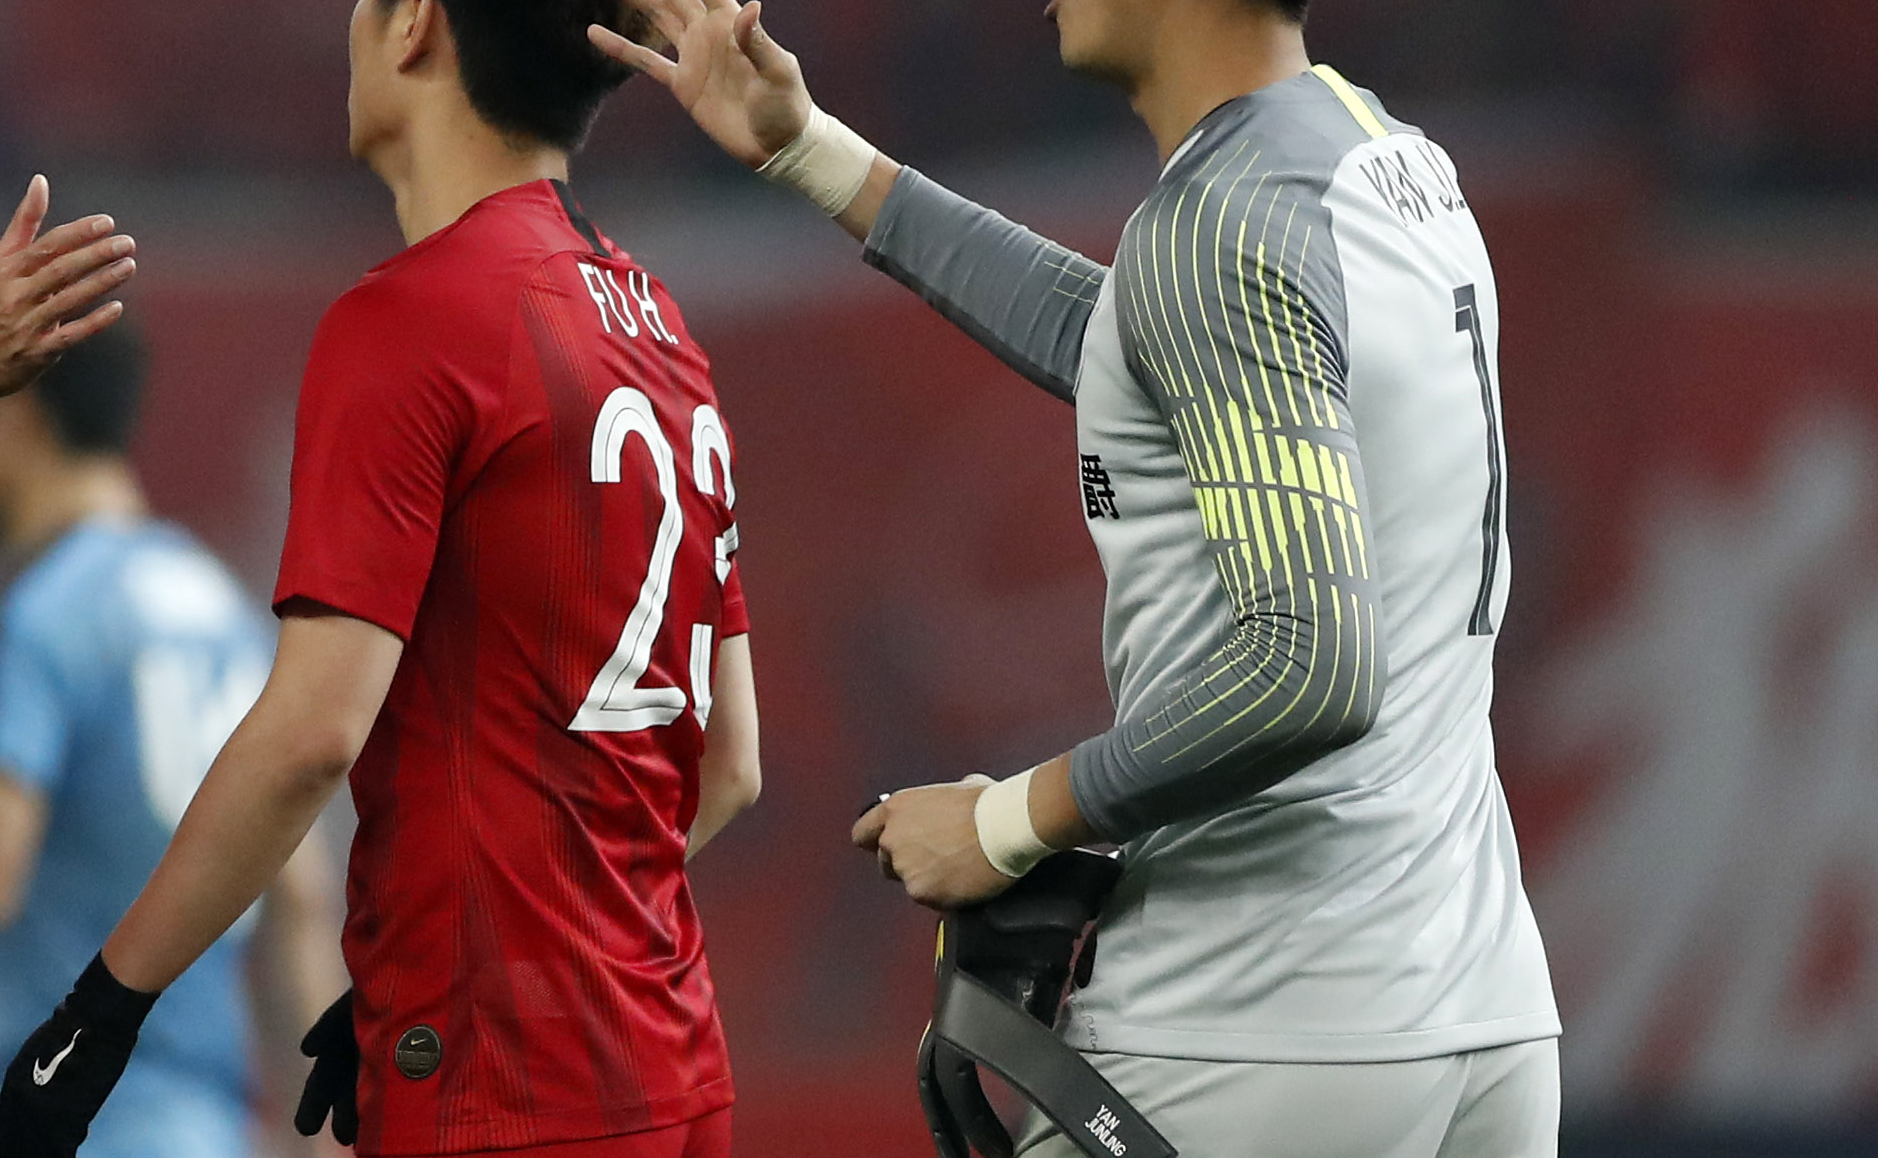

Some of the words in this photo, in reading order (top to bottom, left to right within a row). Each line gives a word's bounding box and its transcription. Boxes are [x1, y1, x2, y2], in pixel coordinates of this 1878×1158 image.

[1358, 149, 1435, 228] YAN
[577, 262, 639, 338] FU
[628, 270, 679, 345] H.
[1452, 282, 1501, 636] 1
[567, 386, 739, 732] 23
[1084, 1117, 1127, 1157] JUNLING
[1096, 1104, 1120, 1131] YAN
